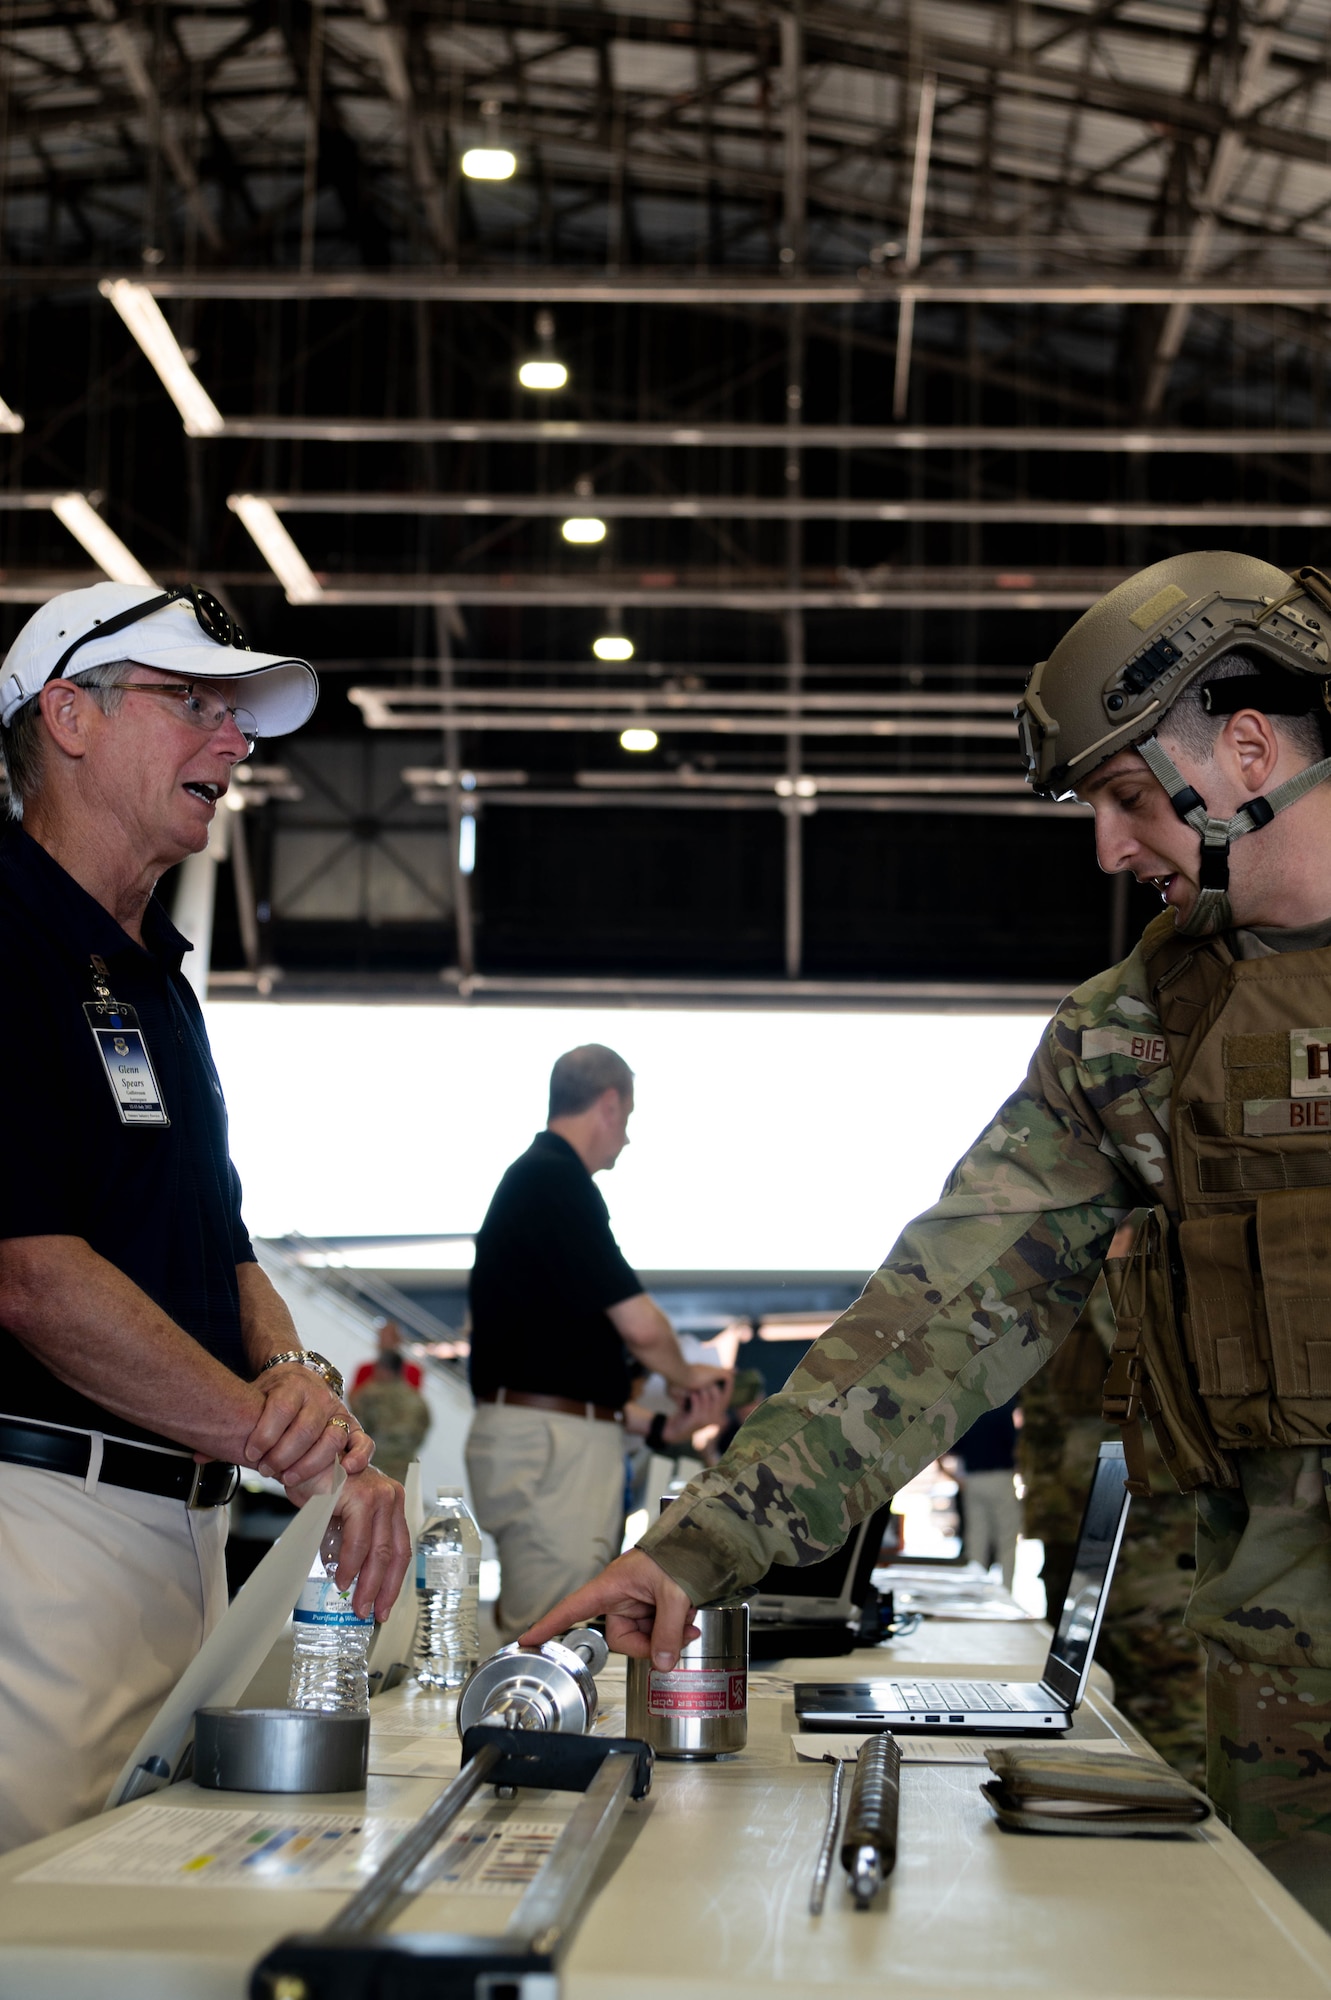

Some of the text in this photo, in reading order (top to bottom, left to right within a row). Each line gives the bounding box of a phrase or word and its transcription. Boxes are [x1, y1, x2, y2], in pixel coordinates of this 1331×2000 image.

[118, 1064, 140, 1074] Glenn
[121, 1078, 145, 1090] Spears
[1290, 1101, 1331, 1127] BIE
[312, 1614, 338, 1623] Purified
[678, 1699, 725, 1707] KESSLER
